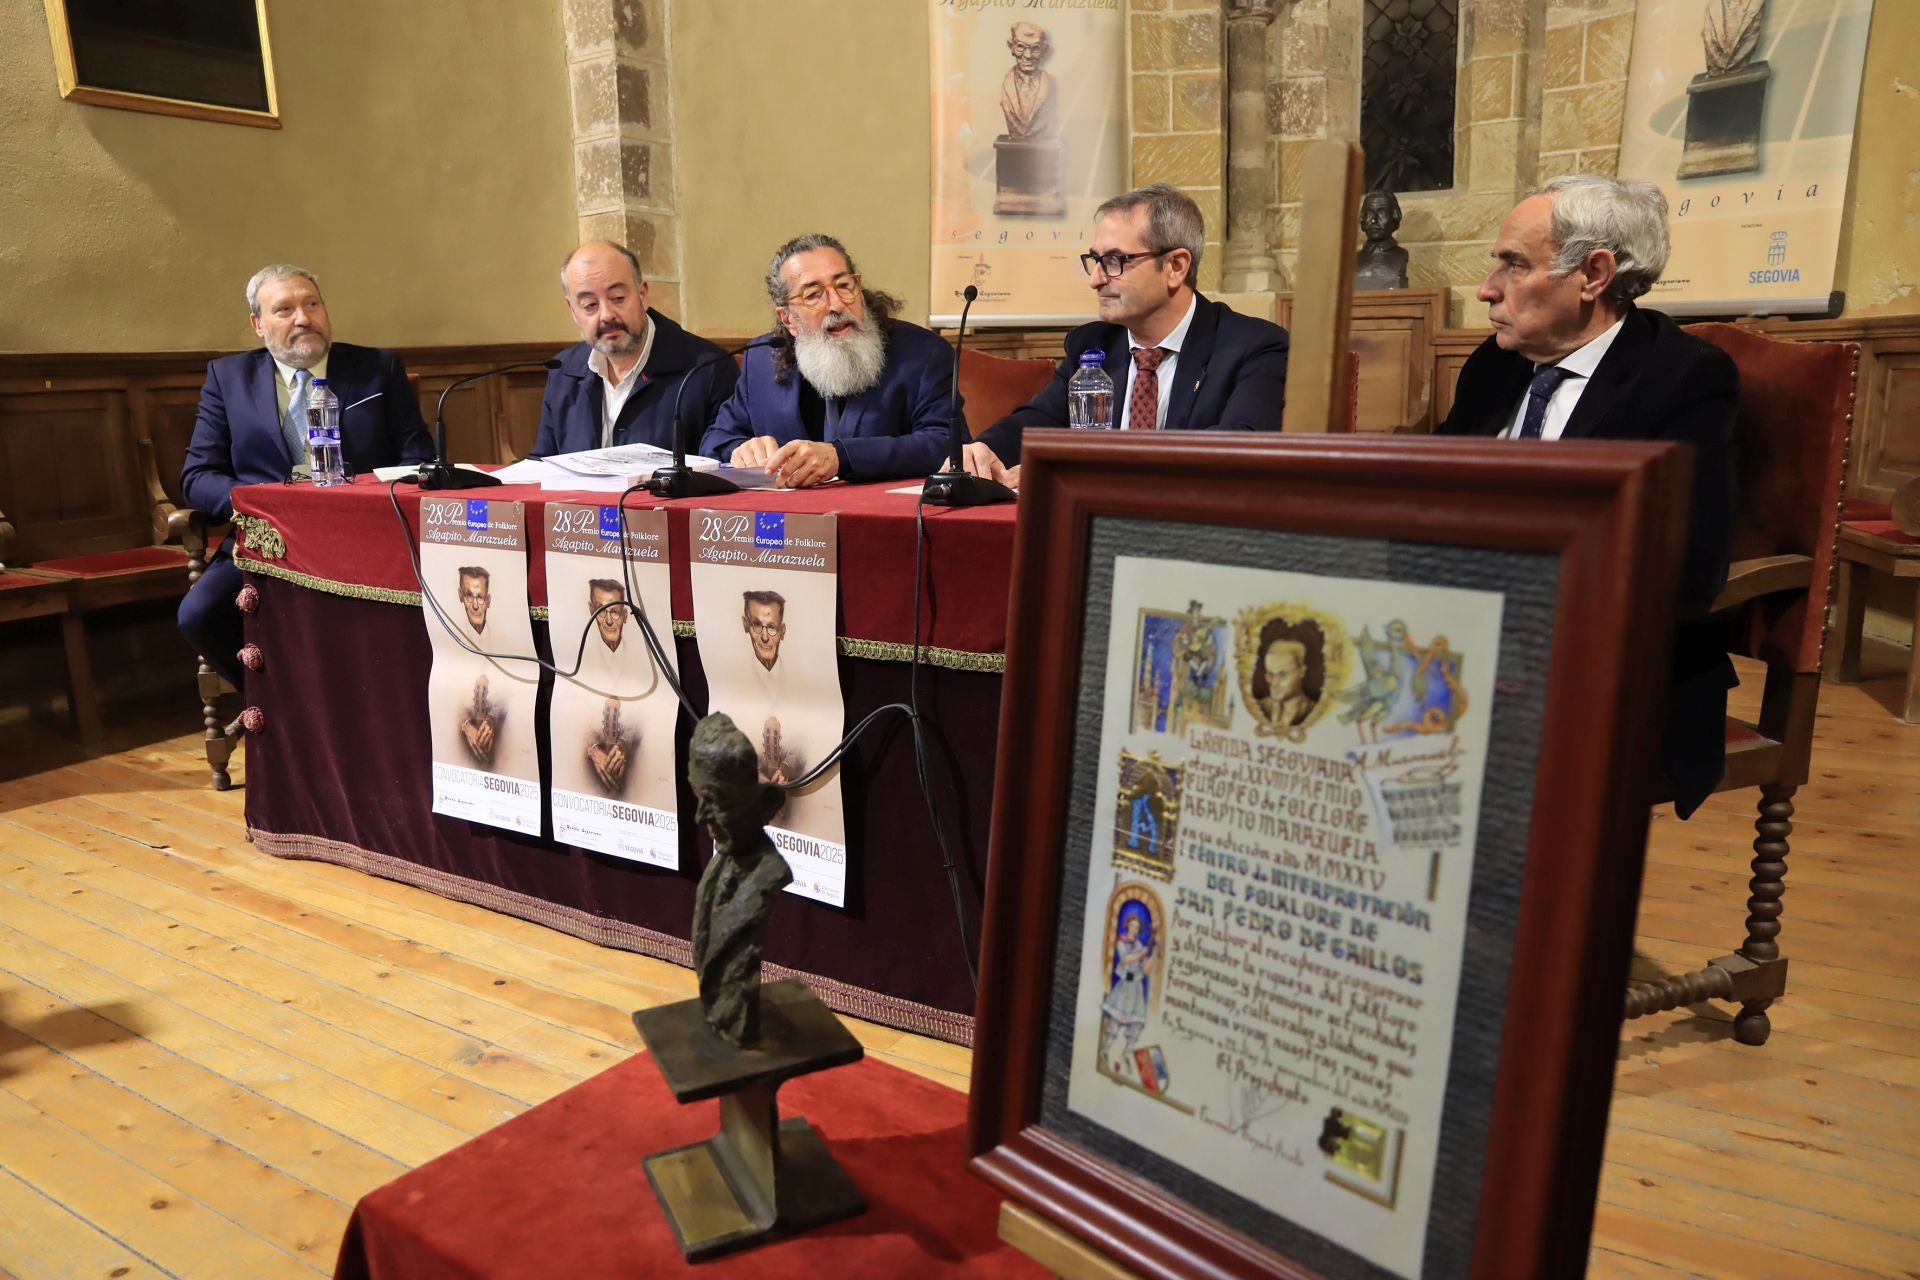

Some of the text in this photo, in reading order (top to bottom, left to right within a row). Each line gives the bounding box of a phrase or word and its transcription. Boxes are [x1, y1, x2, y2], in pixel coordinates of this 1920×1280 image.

[1749, 268, 1800, 284] SEGOVIA
[426, 502, 518, 531] 28 Premio Europeo de Folklore
[552, 510, 572, 533] 28
[572, 509, 600, 534] Premio
[601, 528, 622, 539] Europe
[631, 531, 659, 541] Folklore
[699, 515, 827, 548] 28 Premio Europeo de Folklore
[426, 528, 518, 546] Agapito Marazuela
[552, 536, 594, 553] Agapito
[699, 545, 826, 567] Agapito Marazuela
[1255, 743, 1356, 783] SEGOVIANA
[1185, 771, 1259, 807] EUROPEO
[1277, 794, 1369, 834] FOLCLORE
[1287, 771, 1363, 810] PREMIO
[1183, 793, 1381, 865] AGAPITO MARAZUELA
[1206, 871, 1379, 943] DEL FOLKLORE DE
[1174, 885, 1426, 986] SAN PEDRO DE GAILLOS
